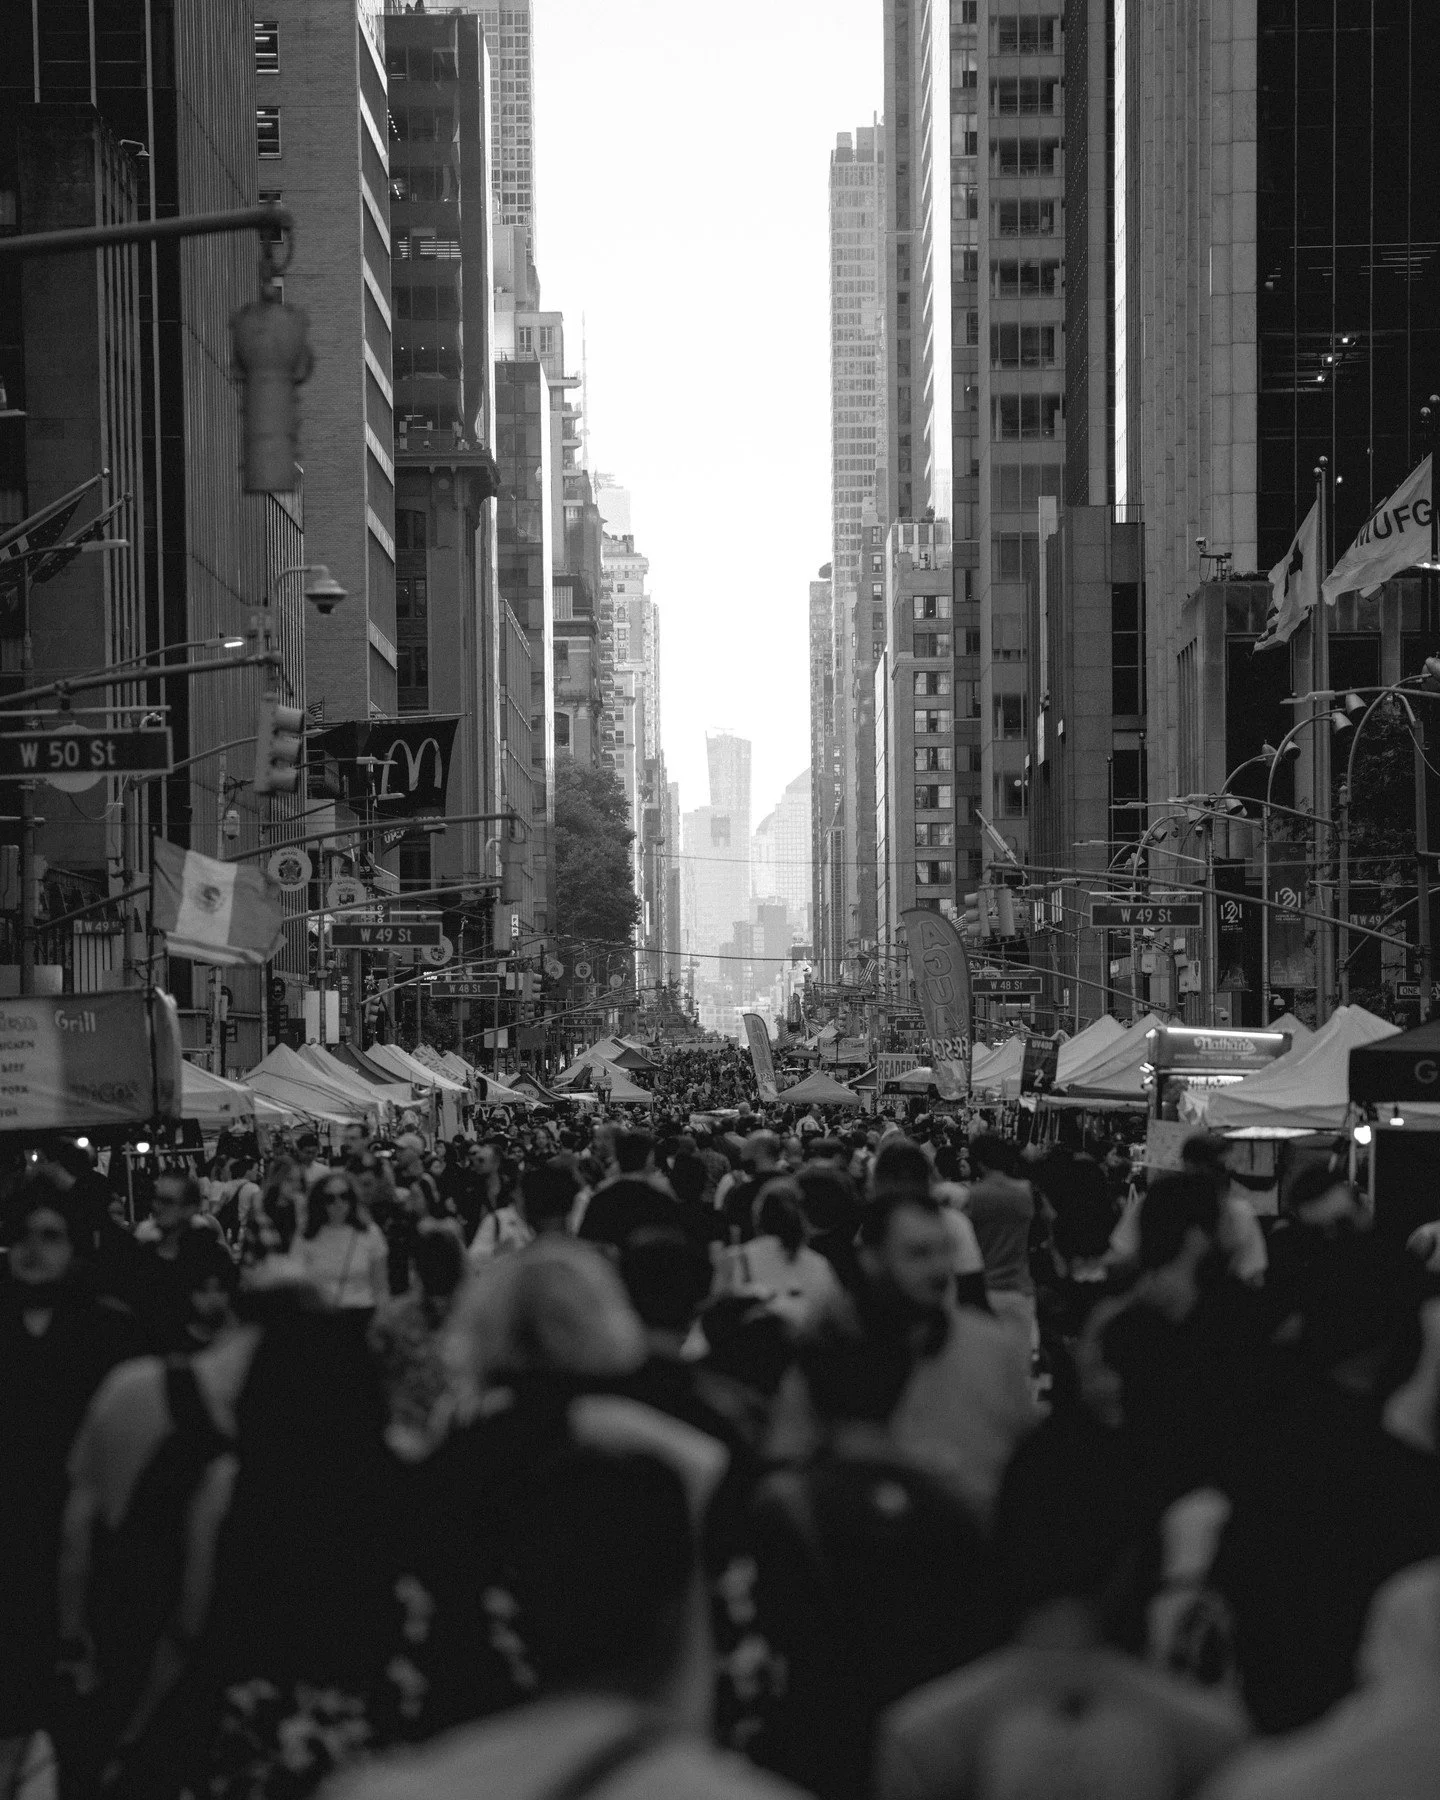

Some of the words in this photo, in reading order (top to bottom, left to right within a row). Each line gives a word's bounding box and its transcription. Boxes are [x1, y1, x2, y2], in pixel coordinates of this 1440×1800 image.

[20, 742, 38, 768] W
[50, 740, 80, 768] 50
[90, 739, 116, 766] St
[1120, 908, 1132, 923] W
[1135, 908, 1153, 923] 49
[1158, 908, 1172, 923] St
[1359, 915, 1367, 925] W
[1369, 915, 1382, 925] 49
[84, 921, 93, 933] W
[94, 921, 109, 933] 49
[360, 928, 371, 942] W
[375, 927, 393, 942] 49
[398, 927, 412, 942] St
[449, 984, 457, 993] W
[459, 983, 470, 993] 48
[472, 983, 481, 993] St
[990, 981, 998, 990] W
[1000, 980, 1011, 990] 48
[1014, 980, 1023, 990] St
[1402, 986, 1418, 995] ONE
[54, 1009, 96, 1033] Grill
[1033, 1068, 1045, 1087] 2
